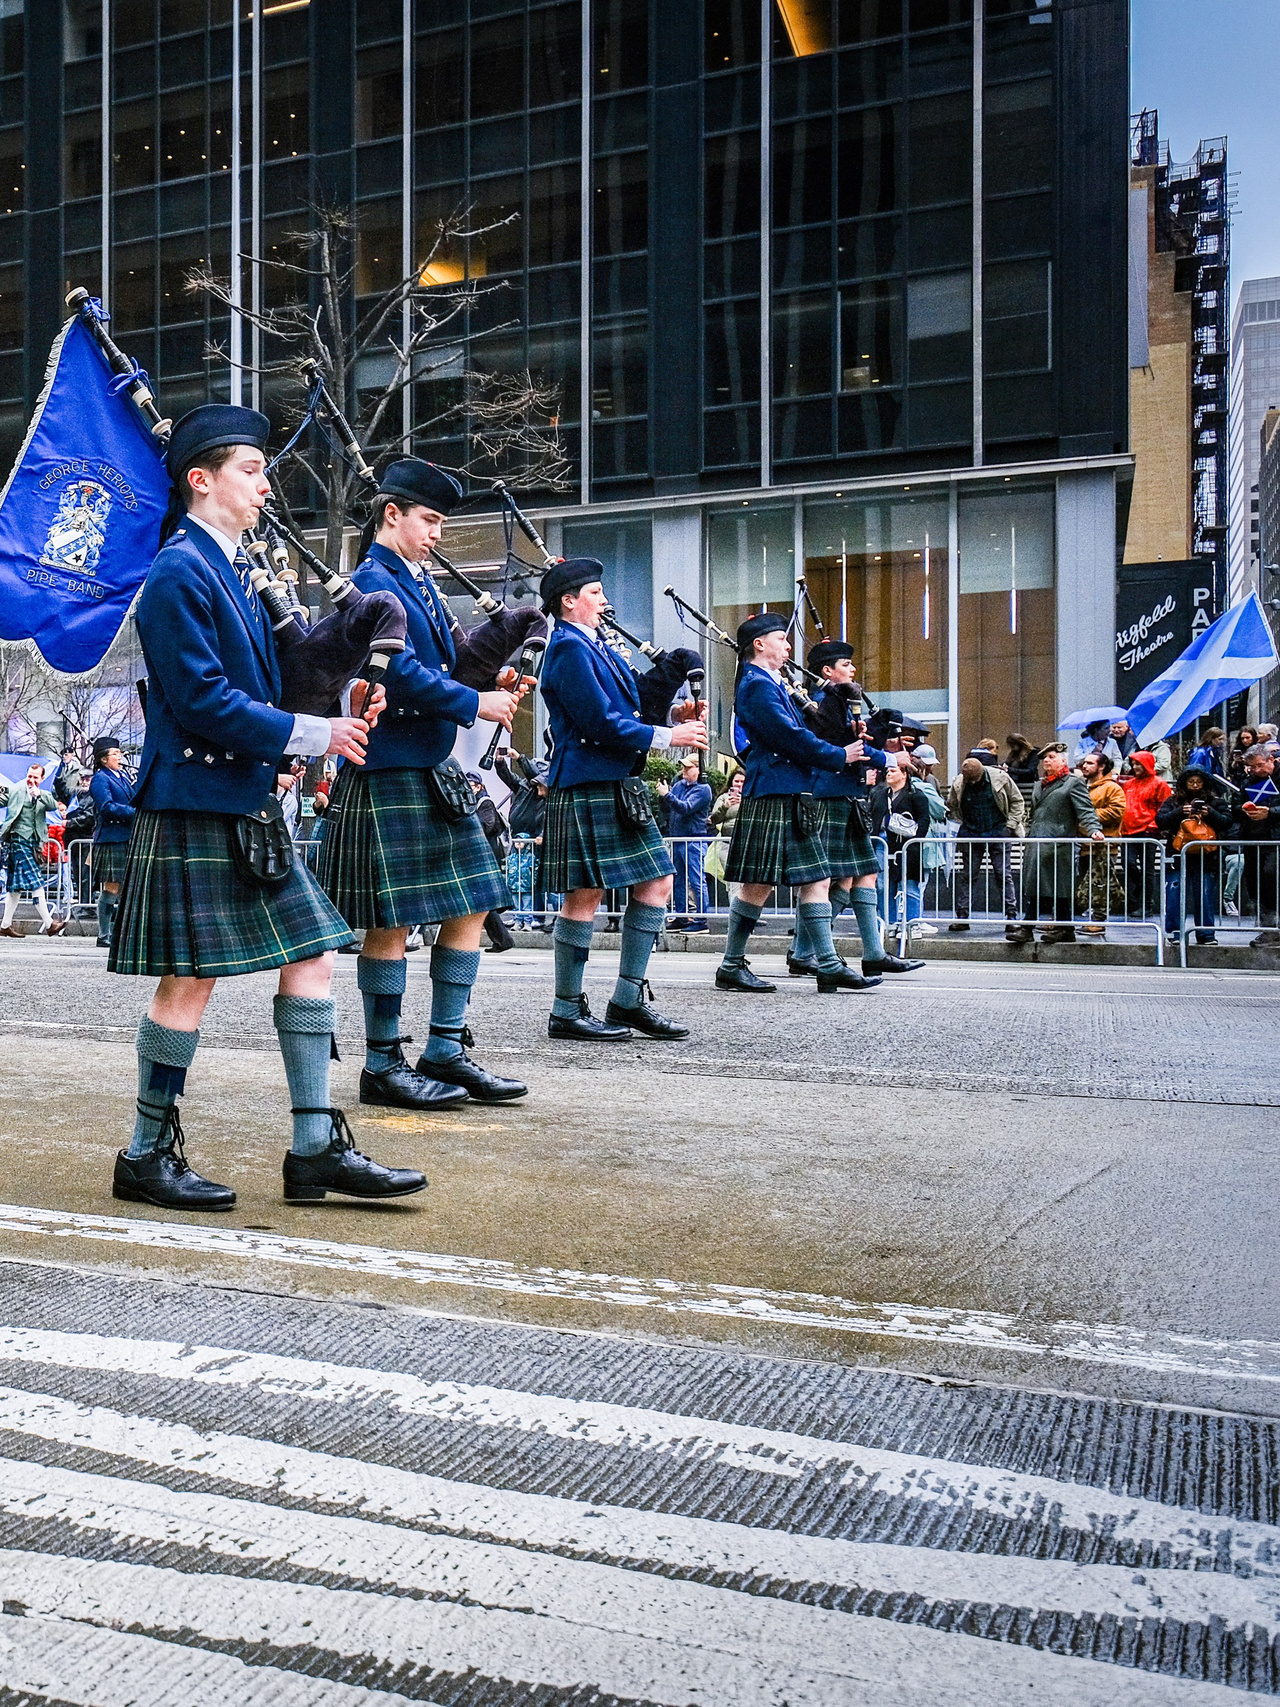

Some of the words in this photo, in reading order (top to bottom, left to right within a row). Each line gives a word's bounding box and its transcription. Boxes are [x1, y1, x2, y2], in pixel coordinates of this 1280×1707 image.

[39, 460, 90, 490] GEORGE
[97, 463, 138, 510] HERIOT'S
[26, 569, 58, 587] PIPE
[67, 579, 105, 599] BAND
[1115, 594, 1176, 653] iegfeld
[1118, 631, 1174, 671] Theatre
